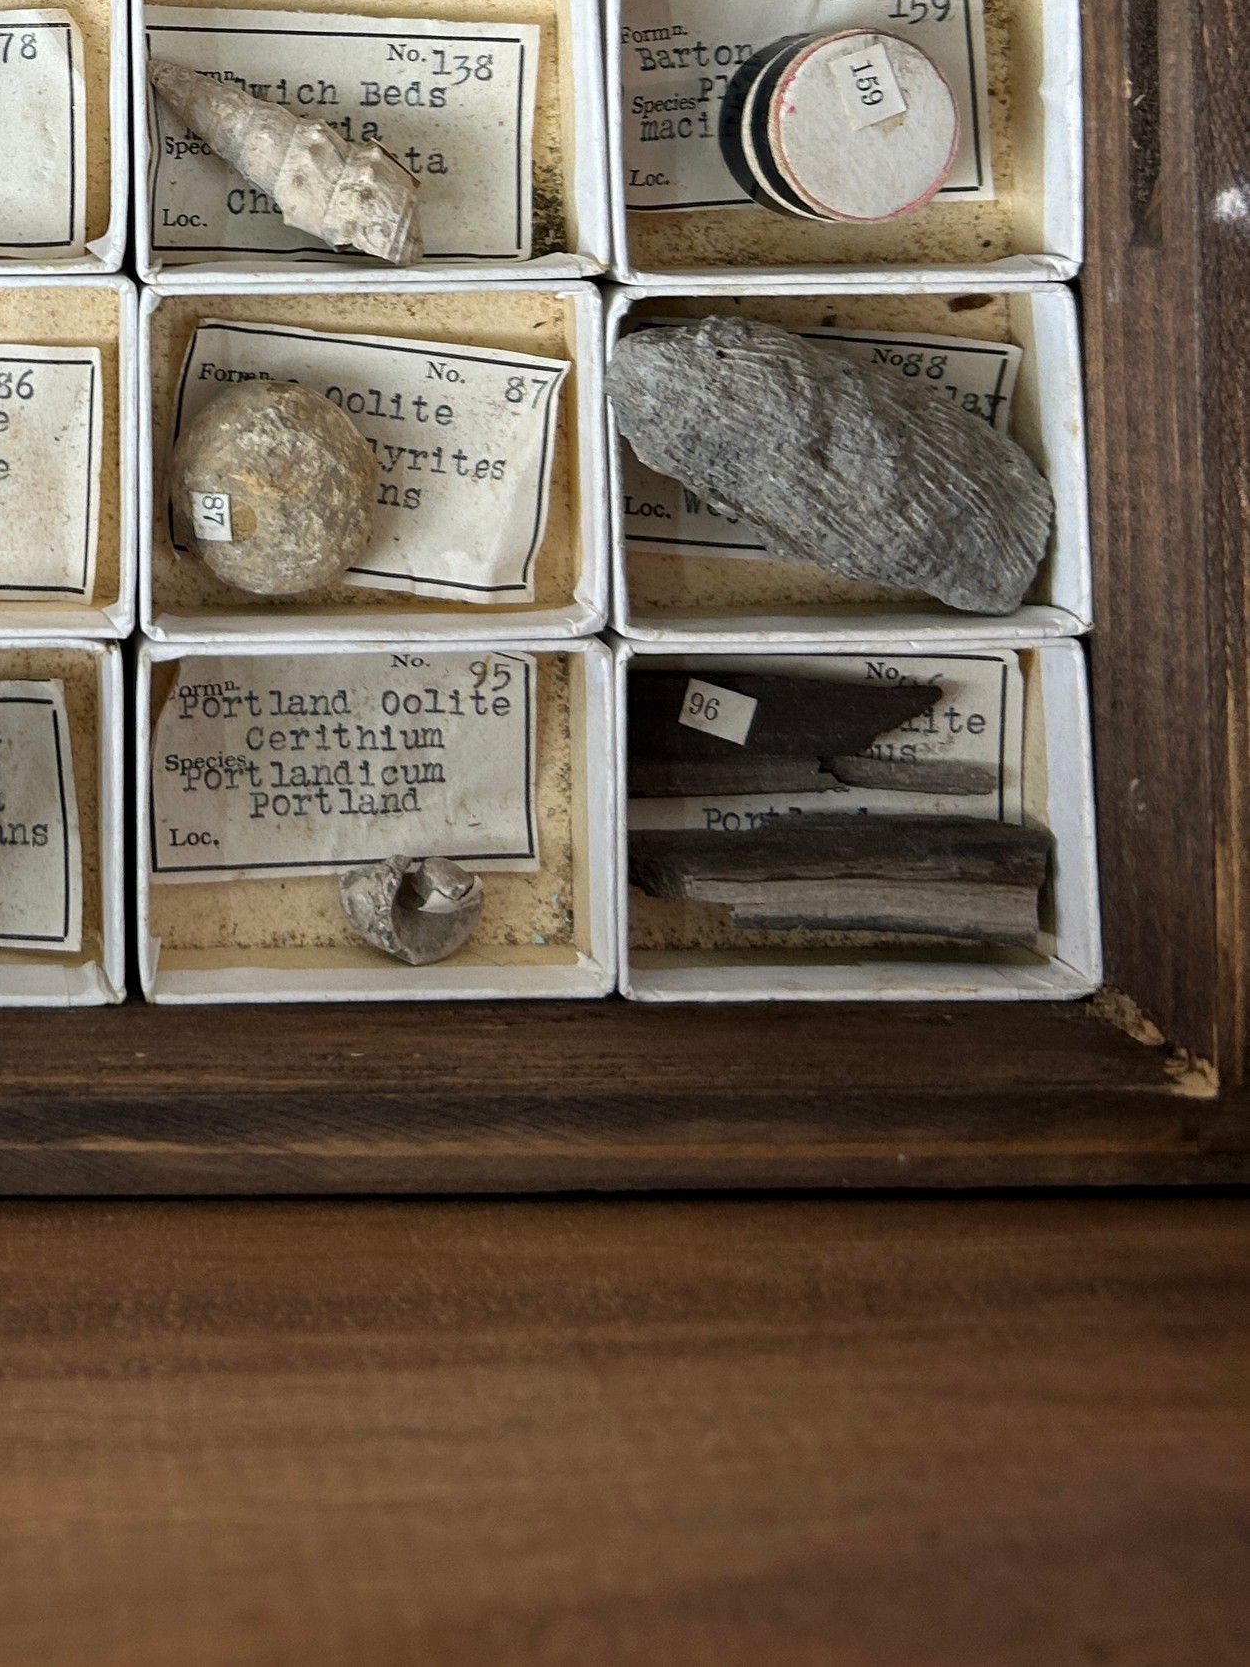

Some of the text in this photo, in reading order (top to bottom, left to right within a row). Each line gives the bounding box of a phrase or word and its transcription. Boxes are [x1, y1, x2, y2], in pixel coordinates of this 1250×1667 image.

[386, 44, 494, 85] No. 138
[360, 81, 448, 107] Beds
[850, 61, 885, 107] 159
[631, 96, 696, 115] Species
[629, 169, 670, 187] Loc.
[162, 209, 208, 228] Loc.
[426, 360, 549, 410] No. 87
[201, 494, 225, 528] 87
[624, 496, 672, 518] Loc.
[390, 654, 513, 693] No. 95
[178, 688, 512, 721] Portland Oolite
[688, 692, 721, 722] 96
[245, 724, 447, 752] Cerithium
[164, 753, 246, 776] Species
[182, 760, 447, 793] Portlandicum
[249, 789, 422, 819] Portland
[169, 829, 220, 848] Loc.
